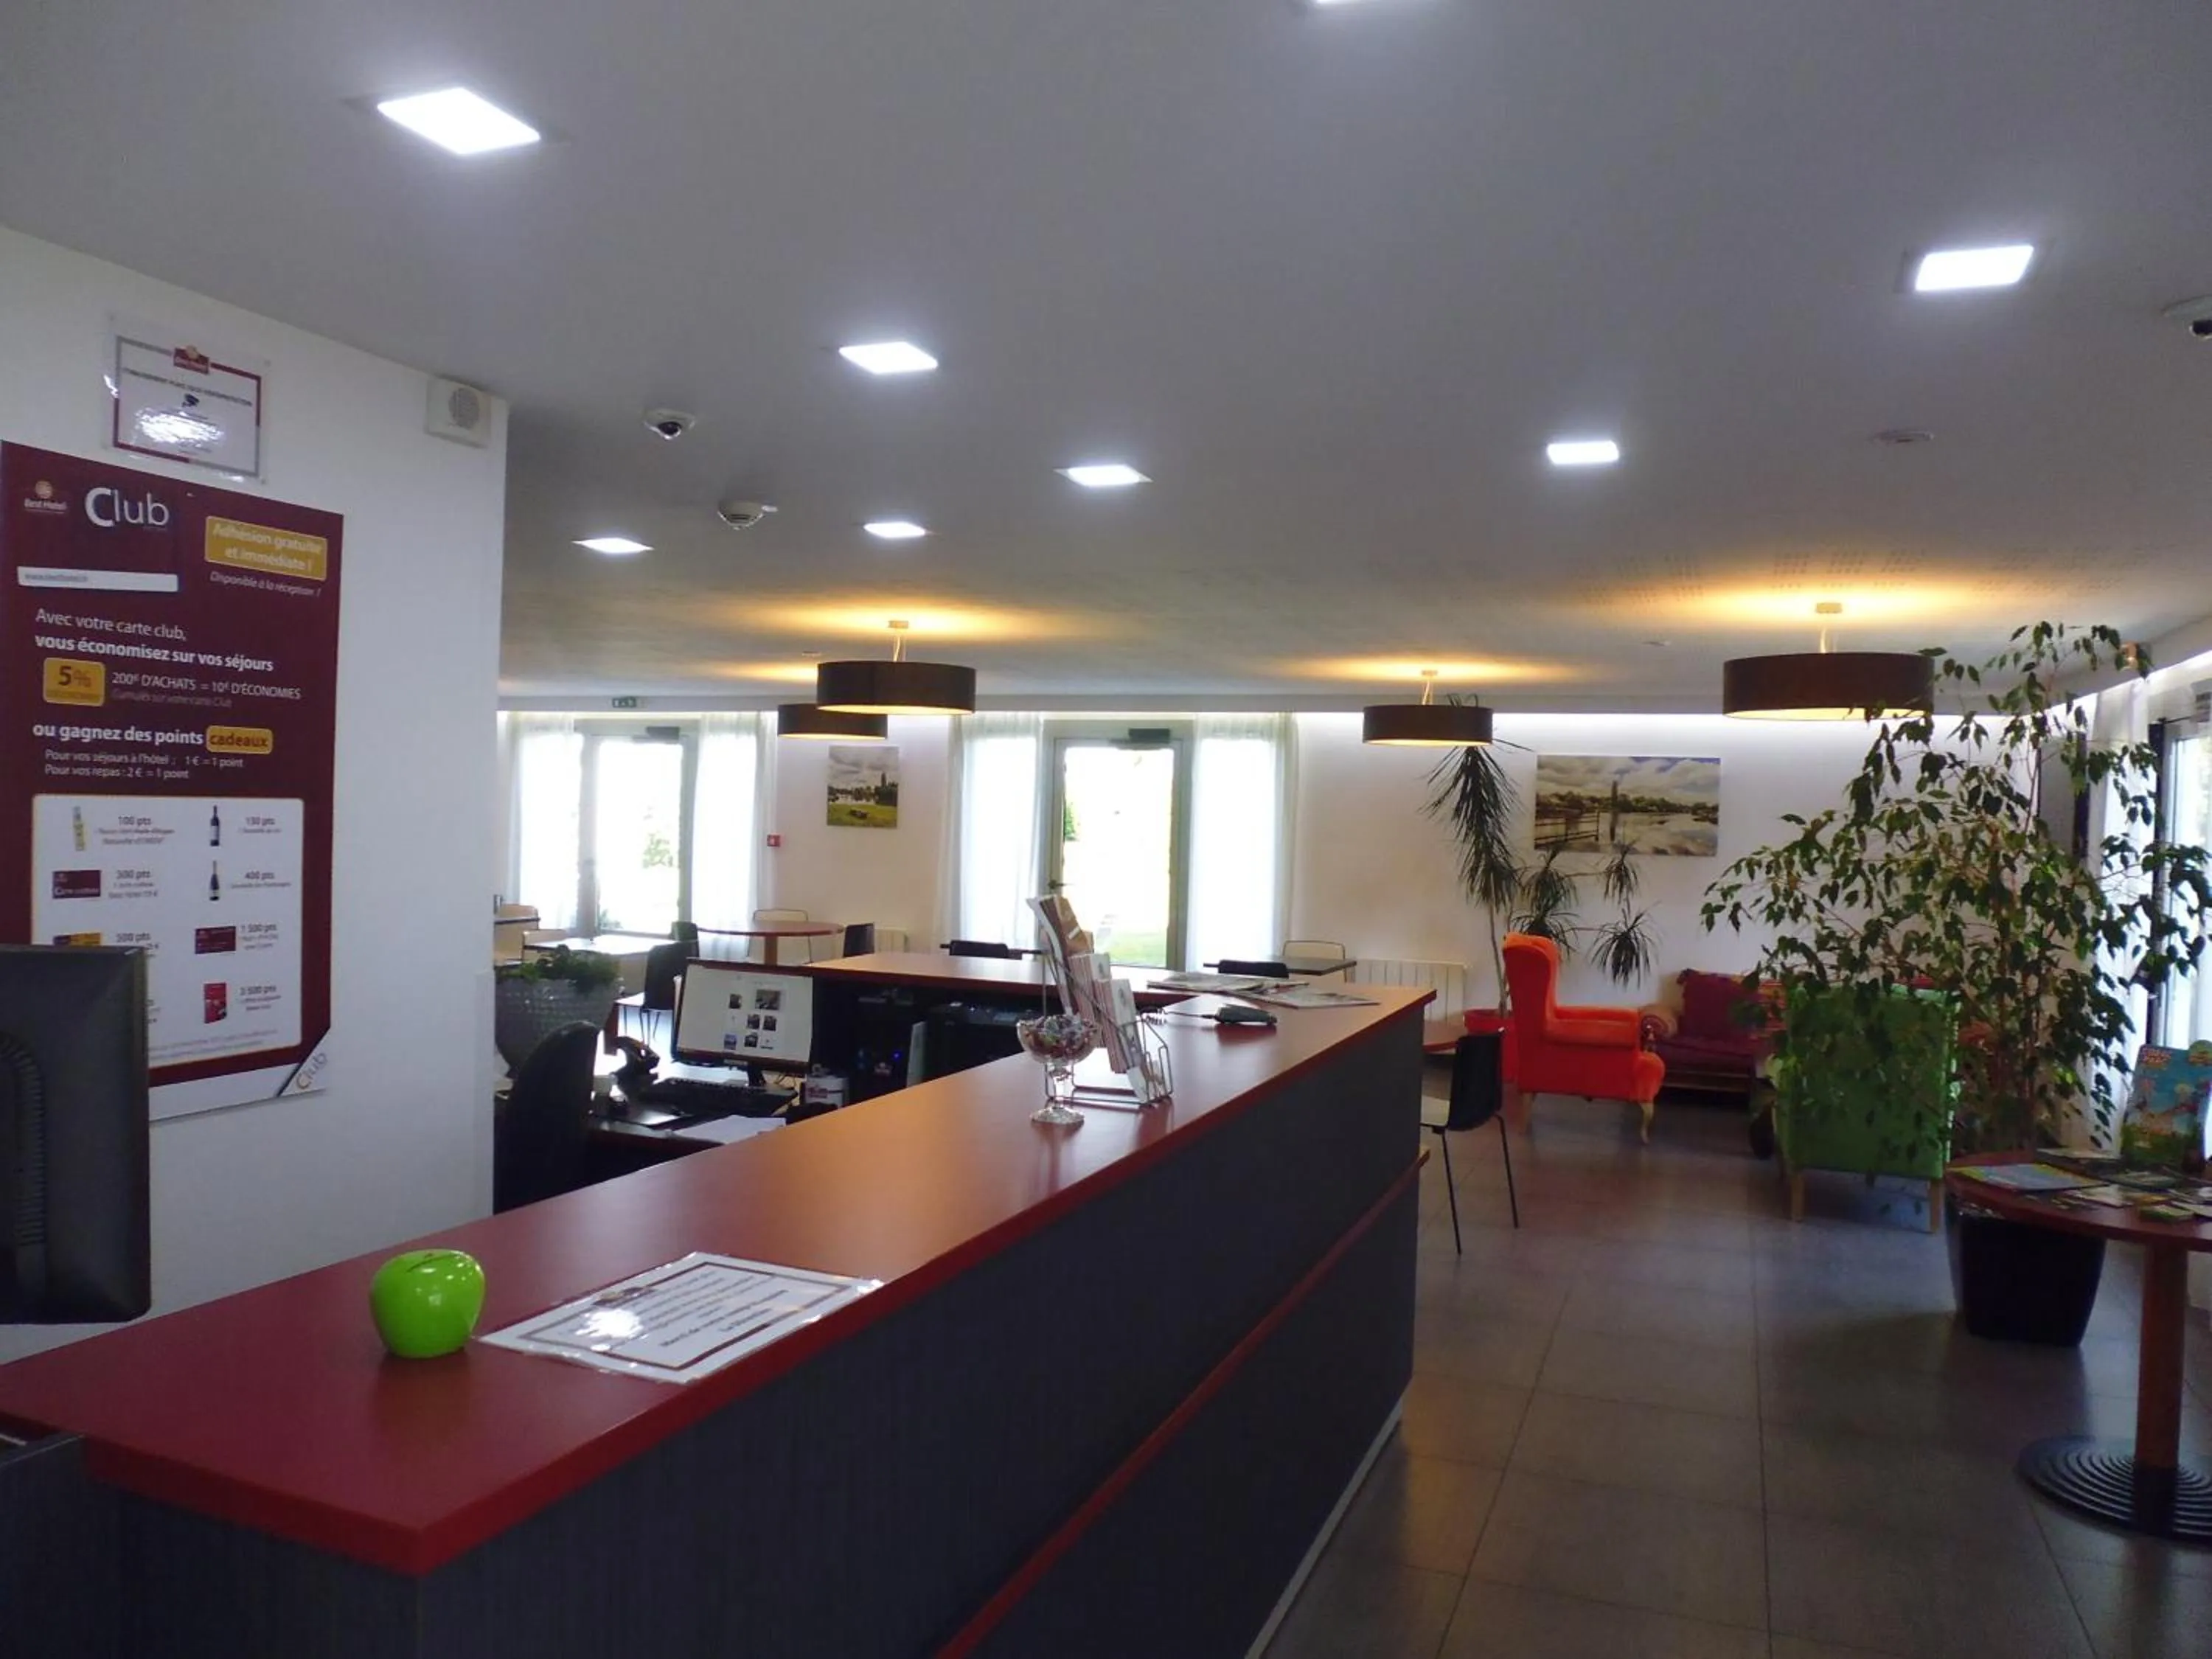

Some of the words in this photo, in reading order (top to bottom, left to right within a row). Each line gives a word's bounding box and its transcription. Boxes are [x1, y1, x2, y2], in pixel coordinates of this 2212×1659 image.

[85, 487, 170, 527] Club
[224, 546, 237, 559] et
[35, 608, 72, 626] Avec
[75, 616, 114, 631] votre
[116, 621, 152, 636] carte
[154, 624, 187, 641] club,
[35, 635, 76, 651] vous
[77, 636, 170, 660] économisez
[172, 650, 195, 663] sur
[197, 653, 223, 666] vos
[224, 653, 274, 672] séjours
[141, 674, 197, 690] D'ACHATS
[32, 724, 56, 737] ou
[58, 726, 122, 742] gagnez
[124, 726, 152, 742] des
[155, 728, 204, 745] points
[209, 731, 268, 748] cadeaux
[45, 748, 70, 760] Pour
[219, 757, 244, 769] point
[44, 763, 70, 776] Pour
[163, 770, 189, 780] point
[296, 1051, 328, 1090] Club
